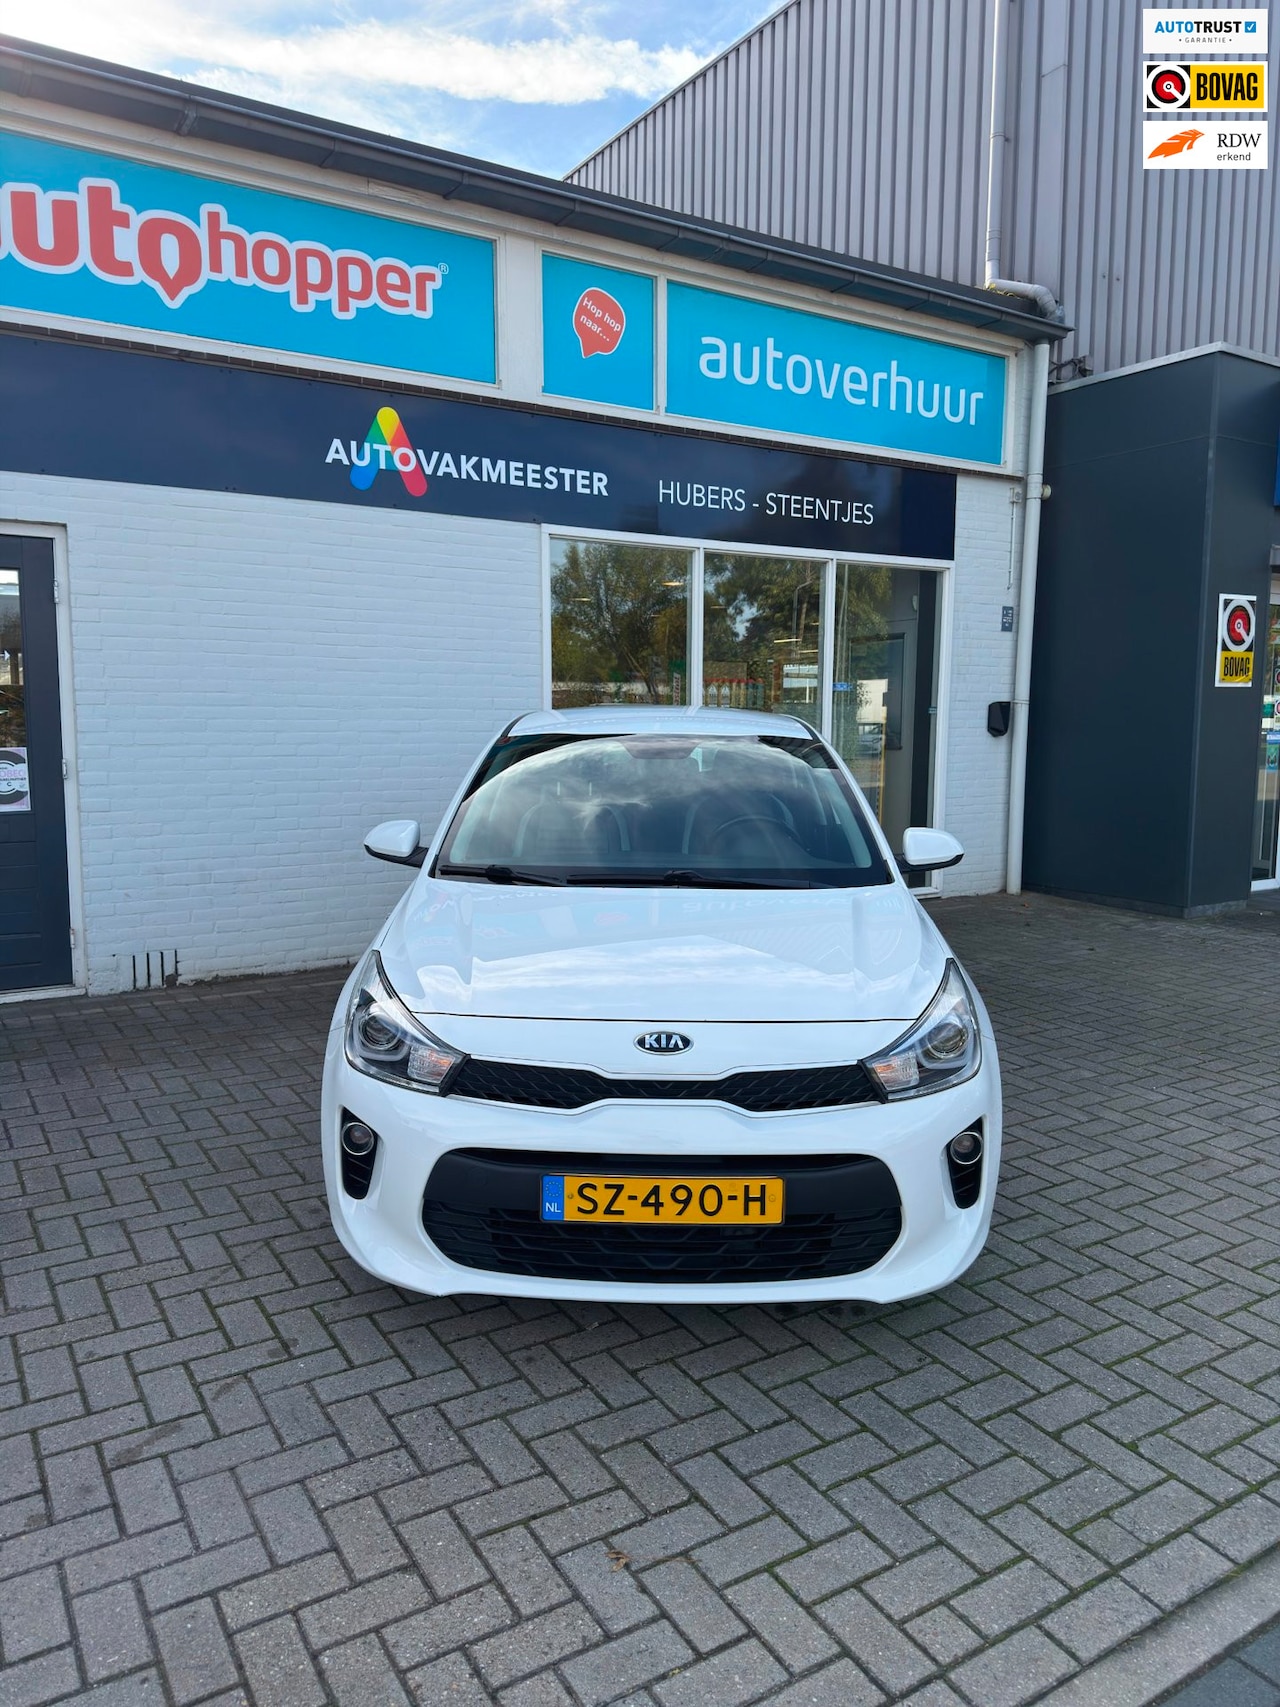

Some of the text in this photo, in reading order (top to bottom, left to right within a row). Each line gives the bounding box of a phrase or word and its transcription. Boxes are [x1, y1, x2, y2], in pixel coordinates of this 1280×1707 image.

[0, 181, 439, 317] utohopper
[583, 298, 621, 332] Hop hop
[699, 336, 983, 425] autoverhuur
[325, 438, 609, 497] AUTOVAKMEESTER
[658, 479, 746, 512] HUBERS
[765, 493, 874, 525] STEENTJES
[1224, 656, 1250, 677] BOVAG
[645, 1034, 684, 1048] KIA
[546, 1202, 561, 1213] NL
[577, 1183, 767, 1217] SZ-490-H
